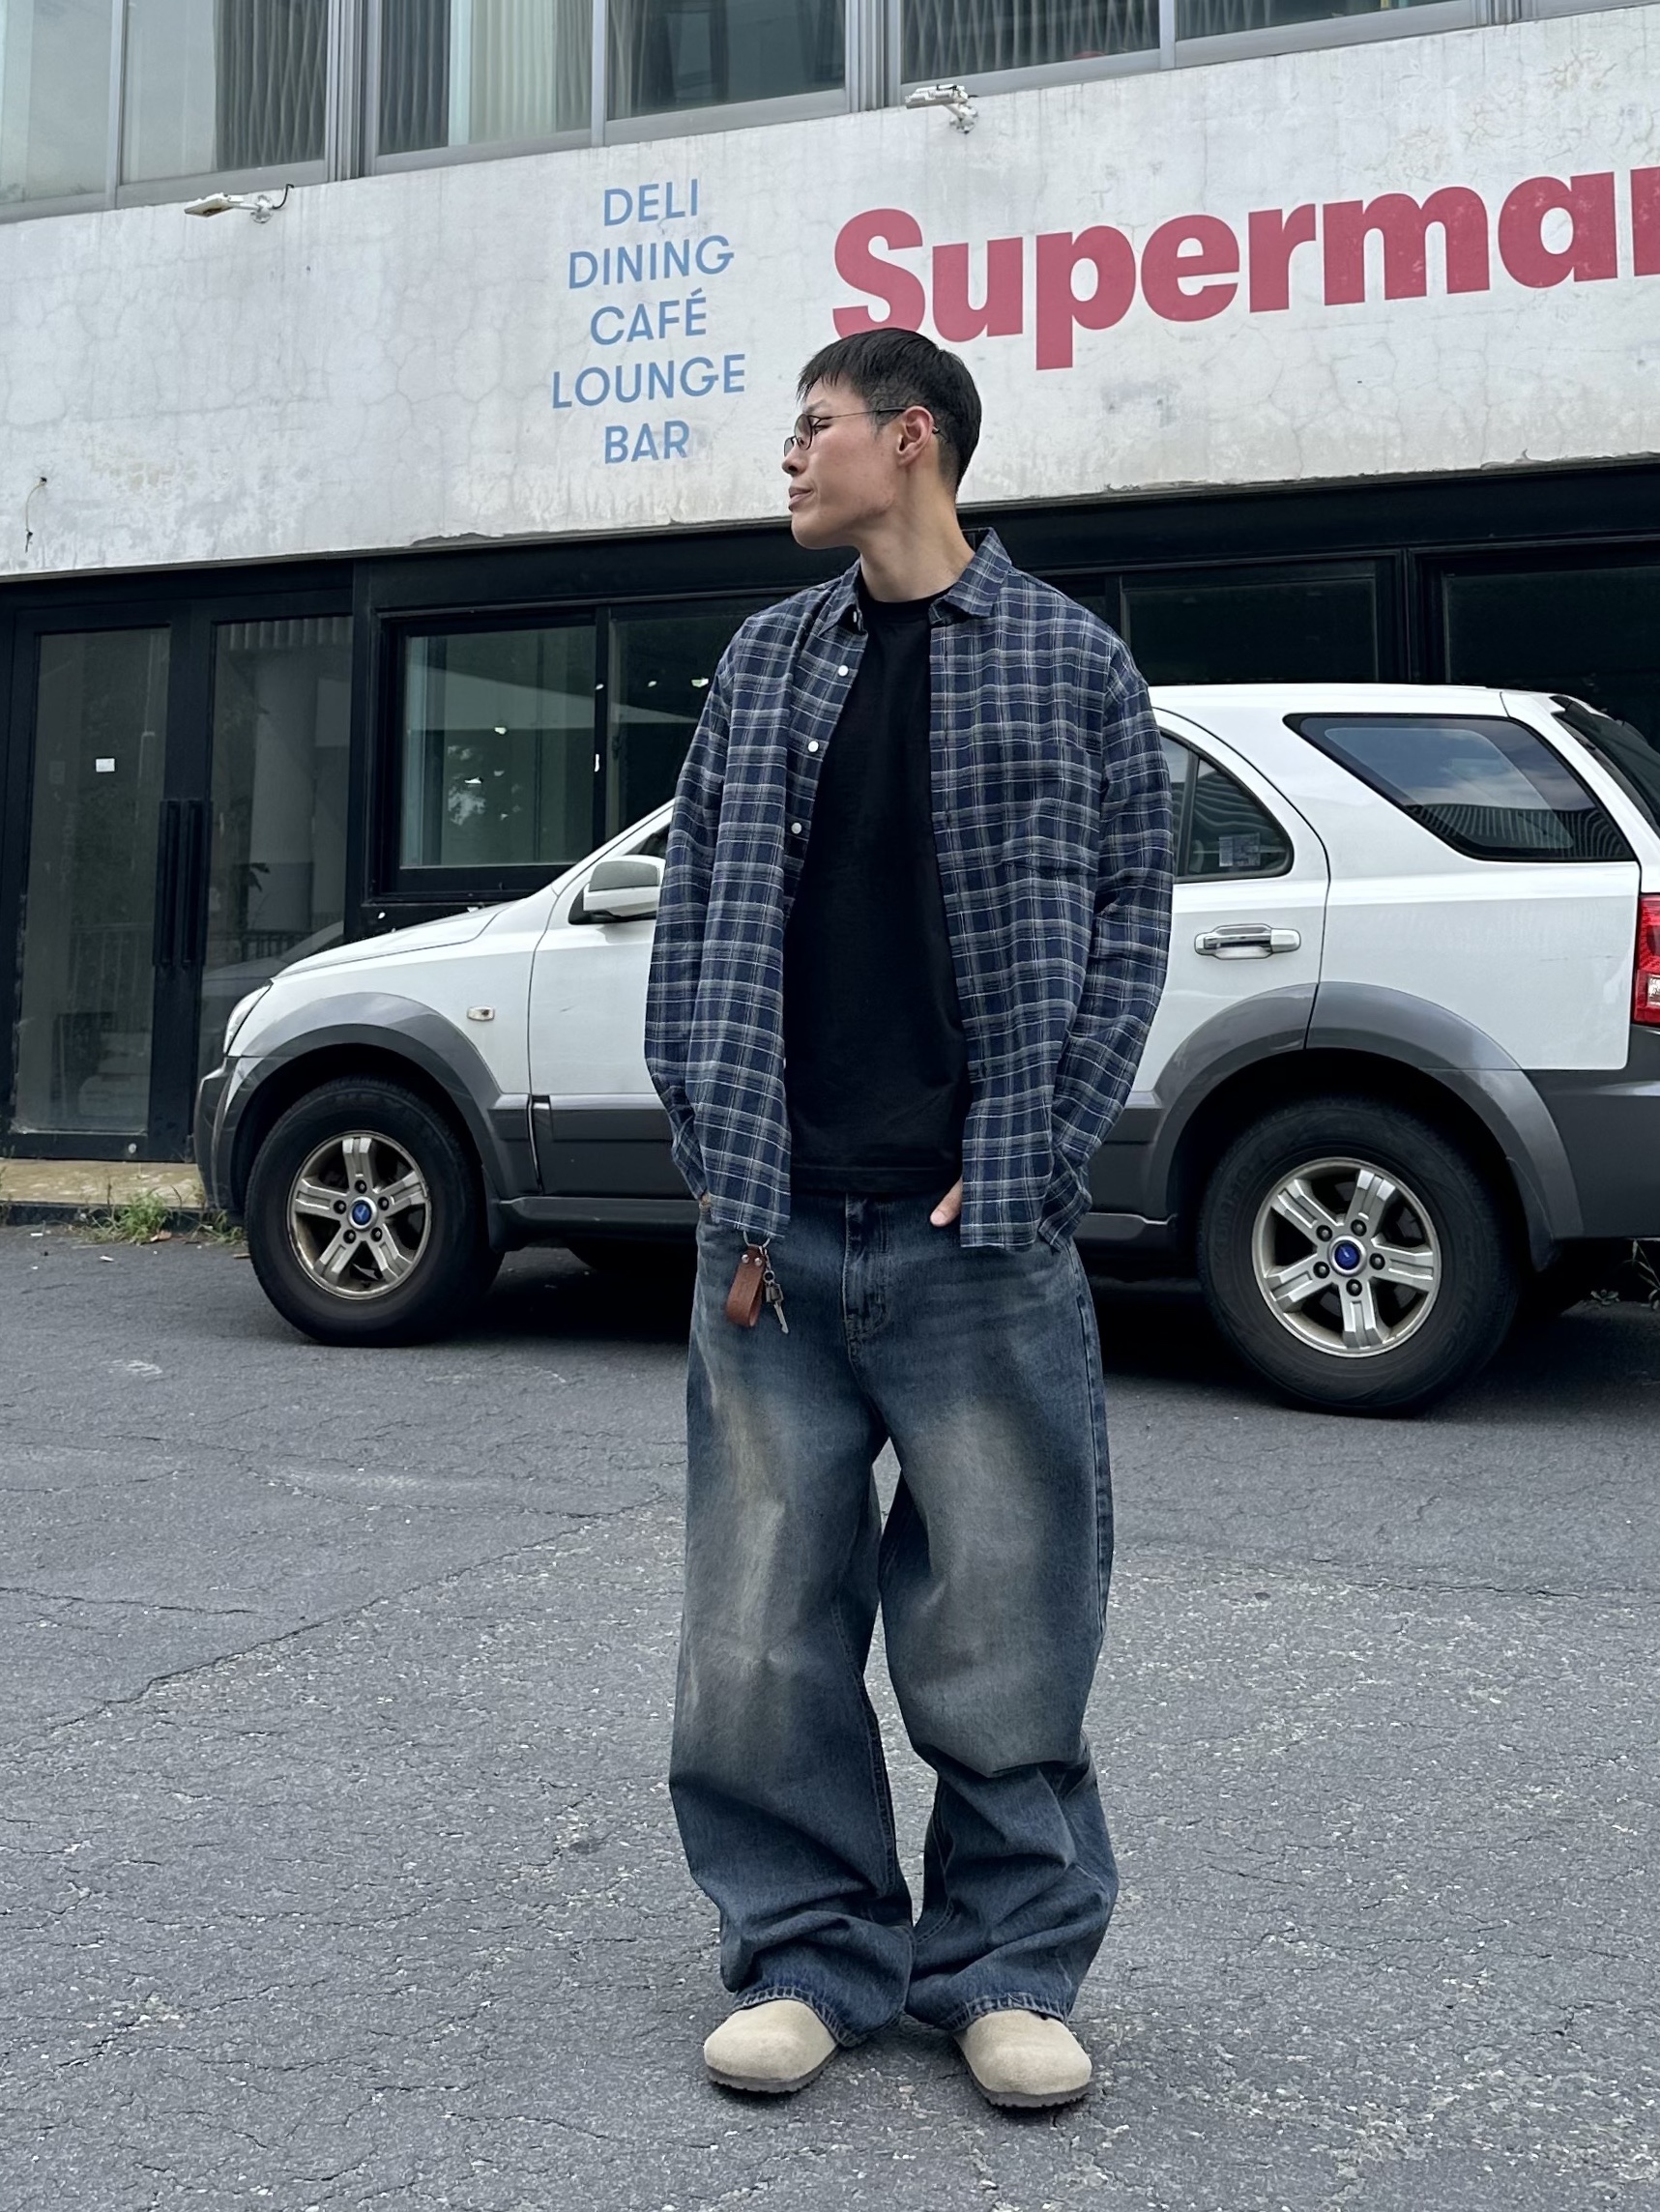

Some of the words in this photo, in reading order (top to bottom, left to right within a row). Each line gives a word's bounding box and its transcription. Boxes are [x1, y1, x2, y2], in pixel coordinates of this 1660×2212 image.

[603, 178, 699, 227] DELI
[568, 234, 735, 289] DINING
[590, 287, 708, 346] CAFÉ
[552, 353, 745, 409] LOUNGE
[603, 420, 690, 464] BAR
